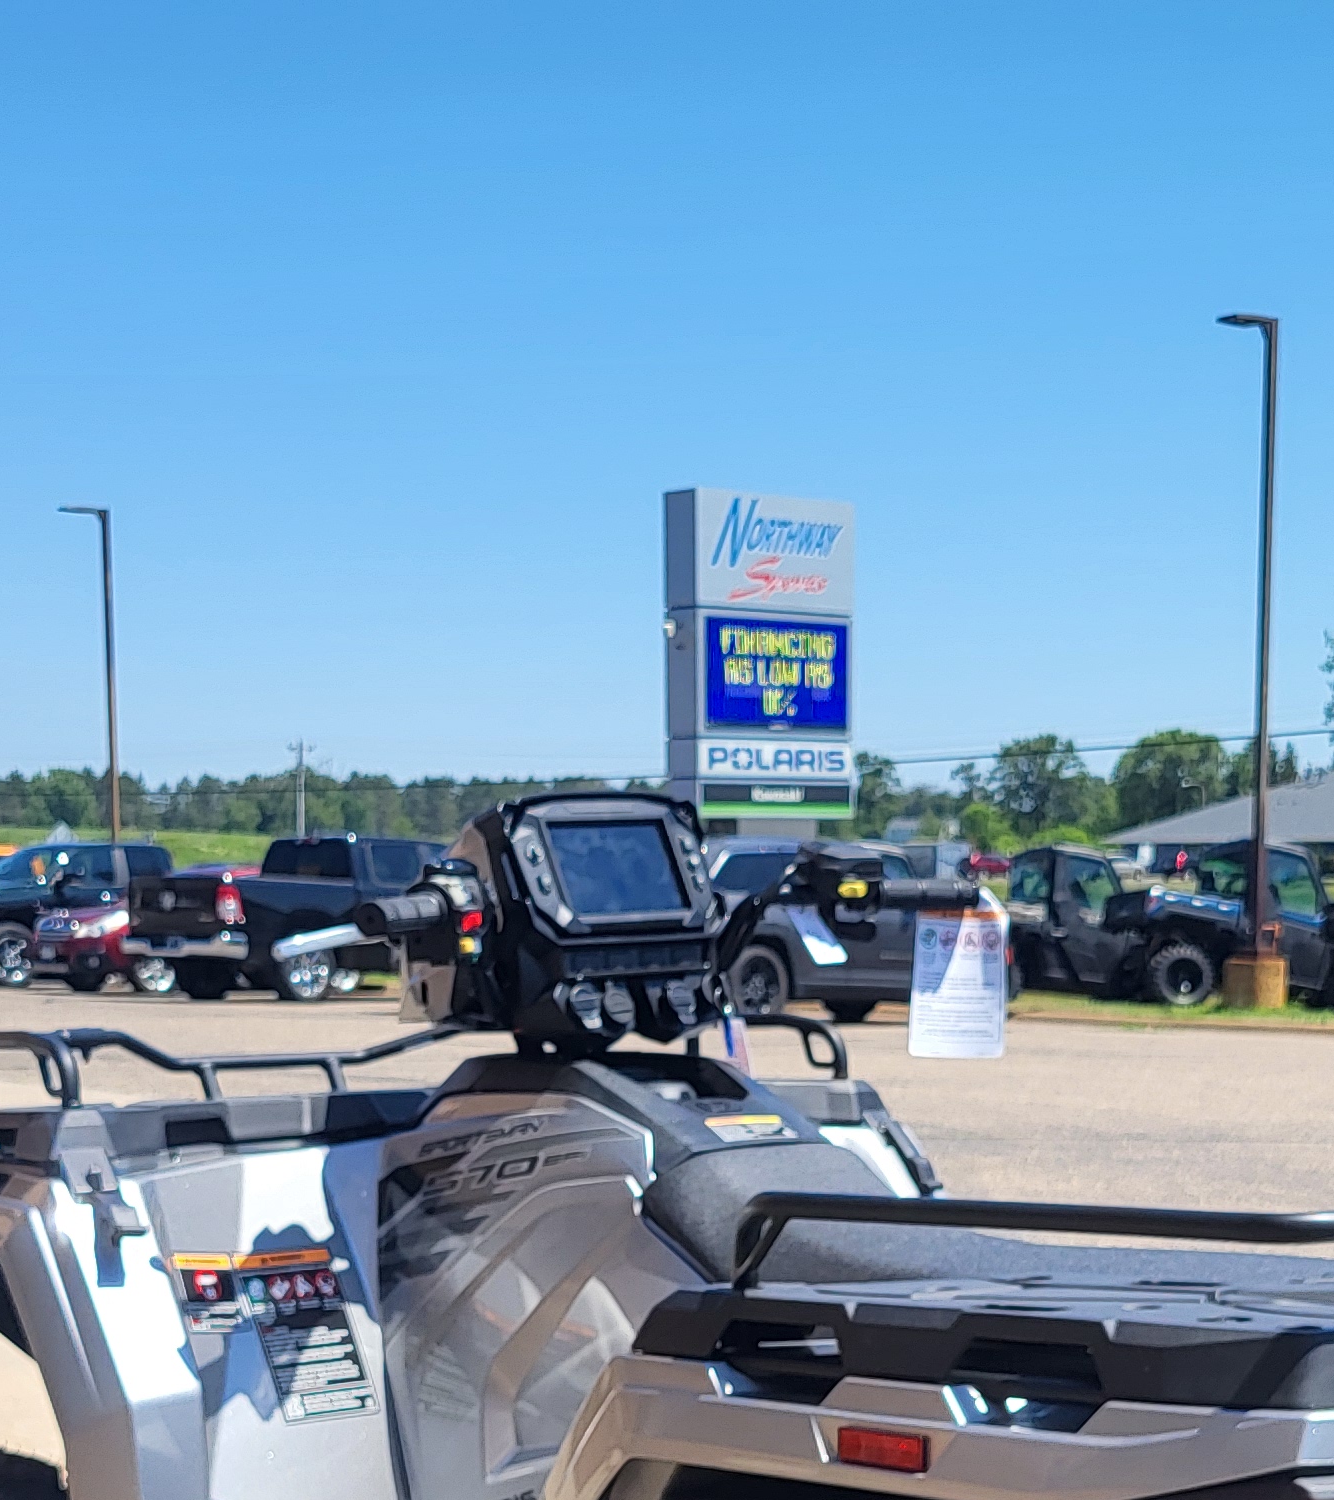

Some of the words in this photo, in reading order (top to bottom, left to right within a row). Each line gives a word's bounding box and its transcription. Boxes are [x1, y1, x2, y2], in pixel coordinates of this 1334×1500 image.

[757, 658, 800, 686] LOW
[708, 747, 845, 773] POLARIS
[423, 1156, 539, 1198] 570
